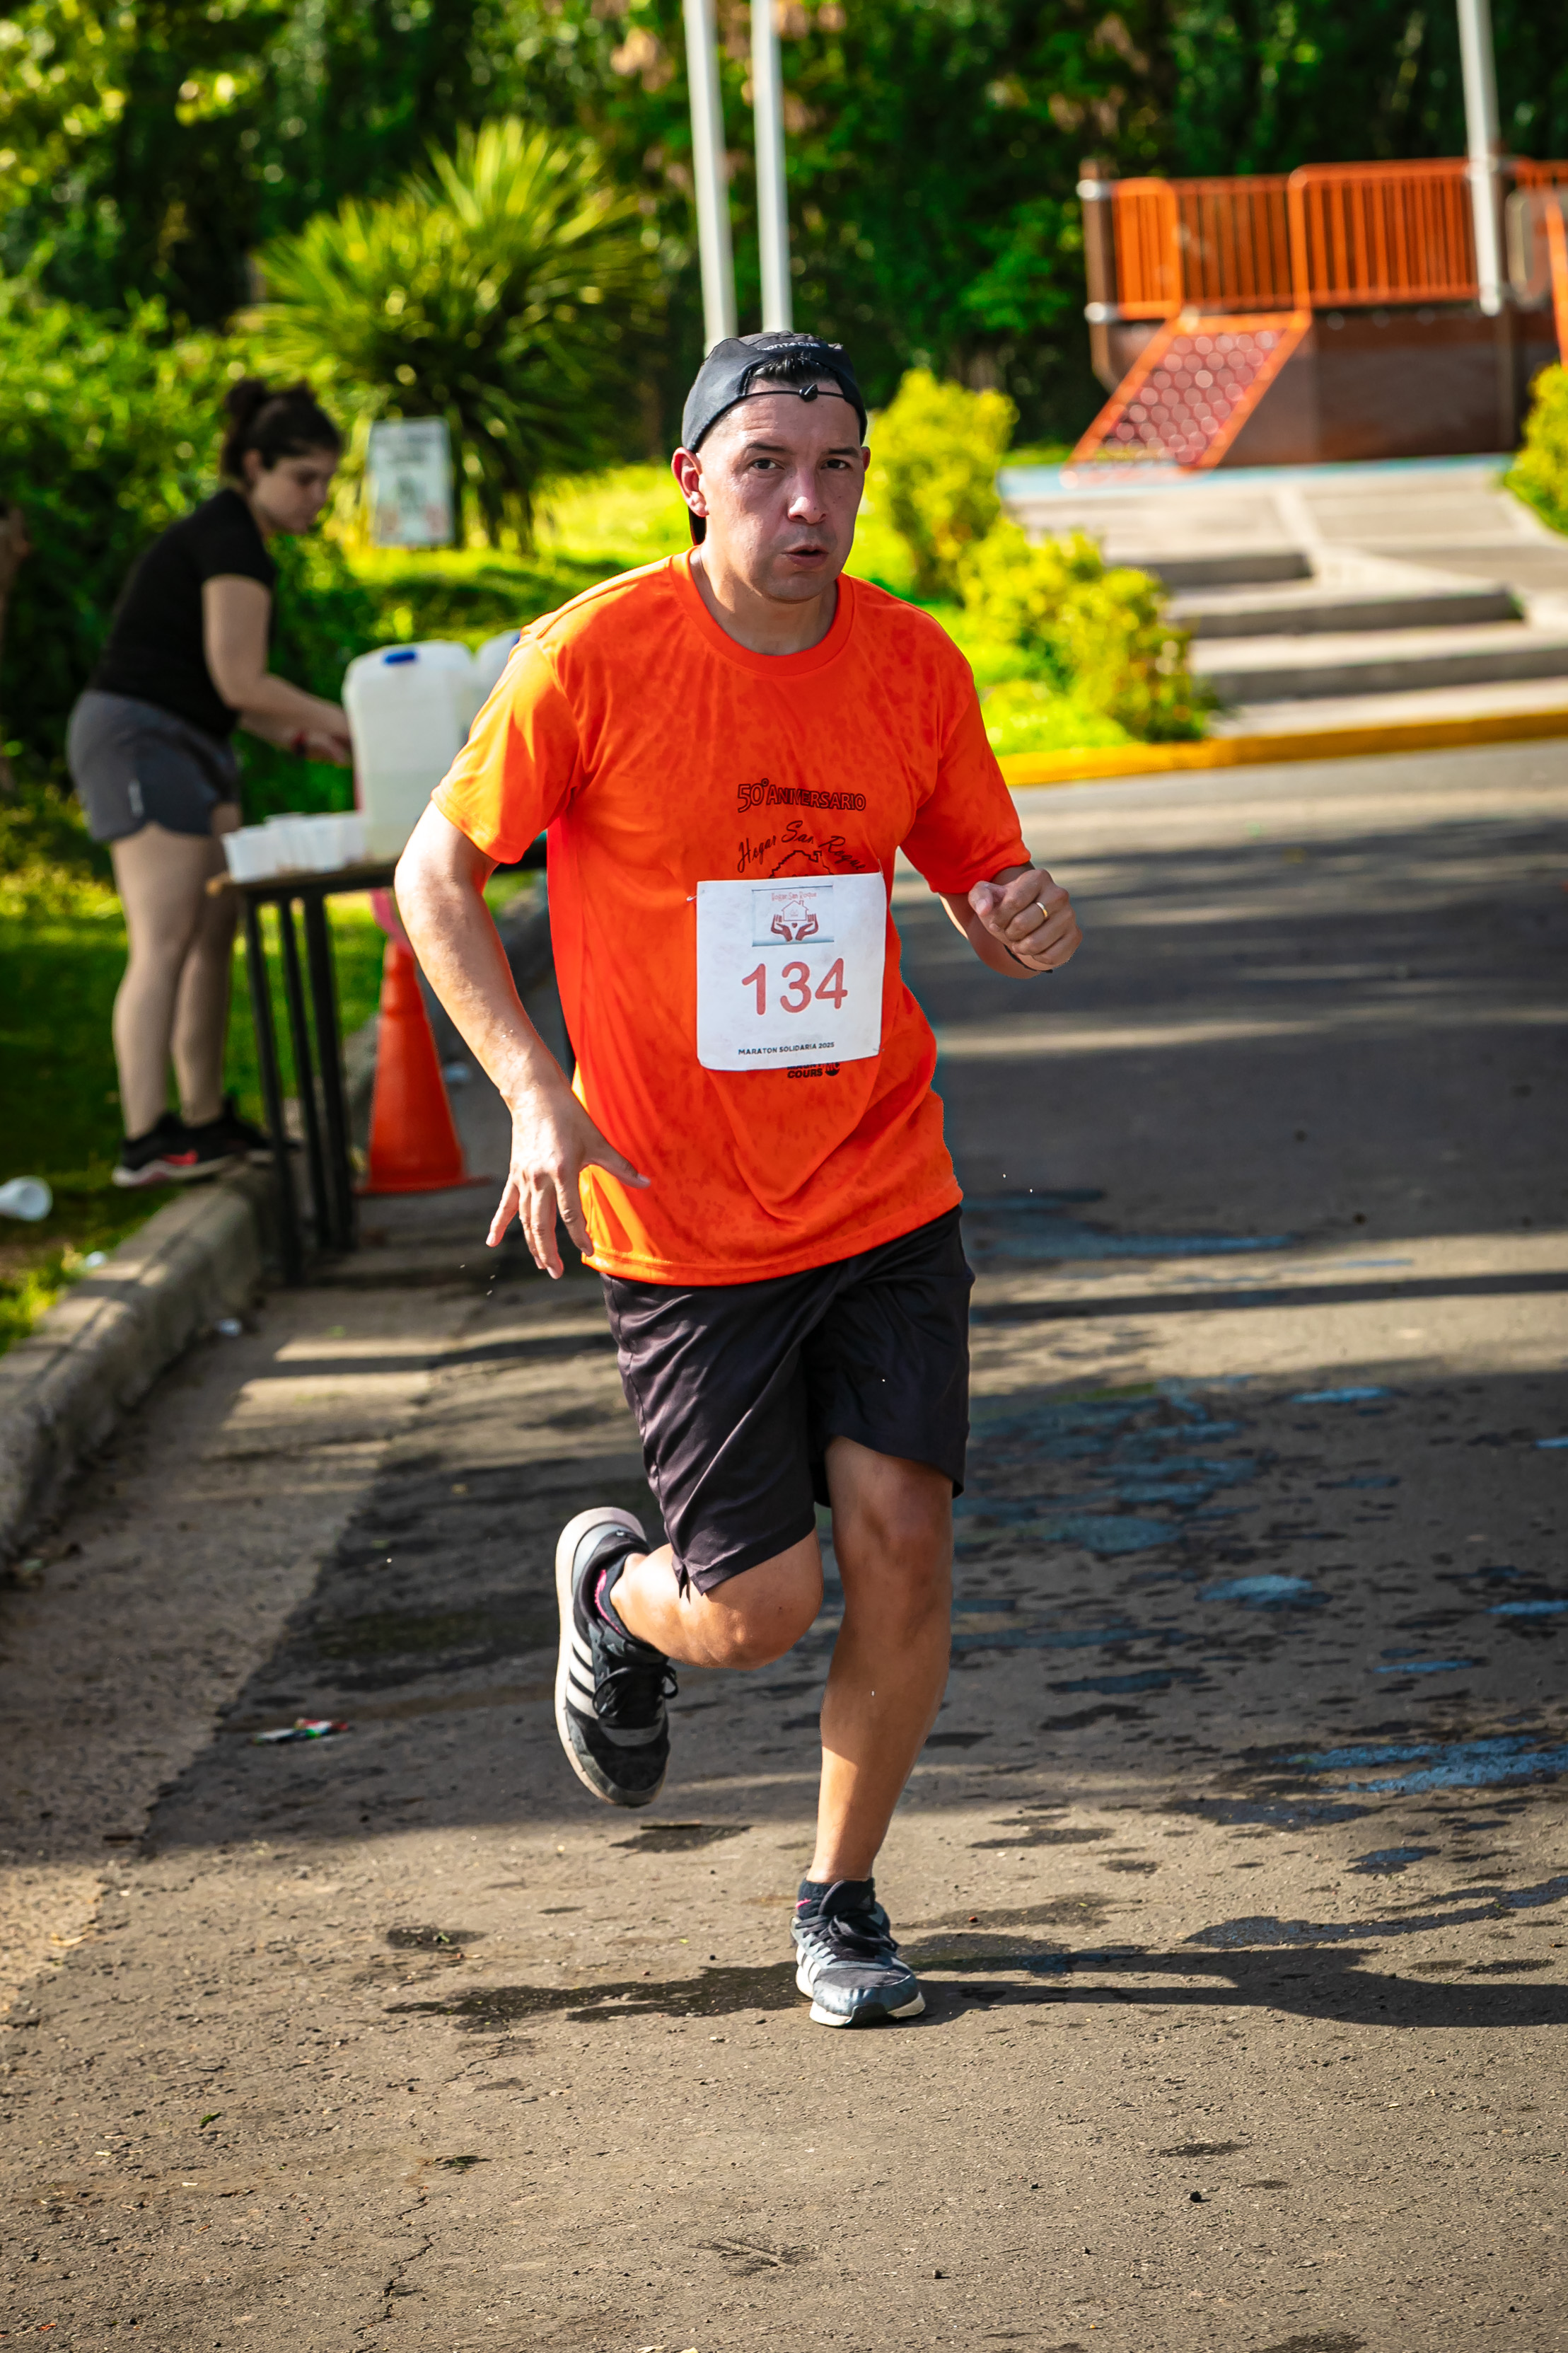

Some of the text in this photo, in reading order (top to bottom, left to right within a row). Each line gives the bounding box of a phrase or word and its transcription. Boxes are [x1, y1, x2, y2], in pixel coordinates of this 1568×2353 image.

[766, 784, 866, 811] ANIVERSARIO
[738, 820, 866, 874] Hogar San Roque
[741, 957, 848, 1016] 134
[738, 1047, 778, 1056] MARATON
[779, 1043, 817, 1053] SOLIDARIA
[787, 1068, 823, 1079] COURS
